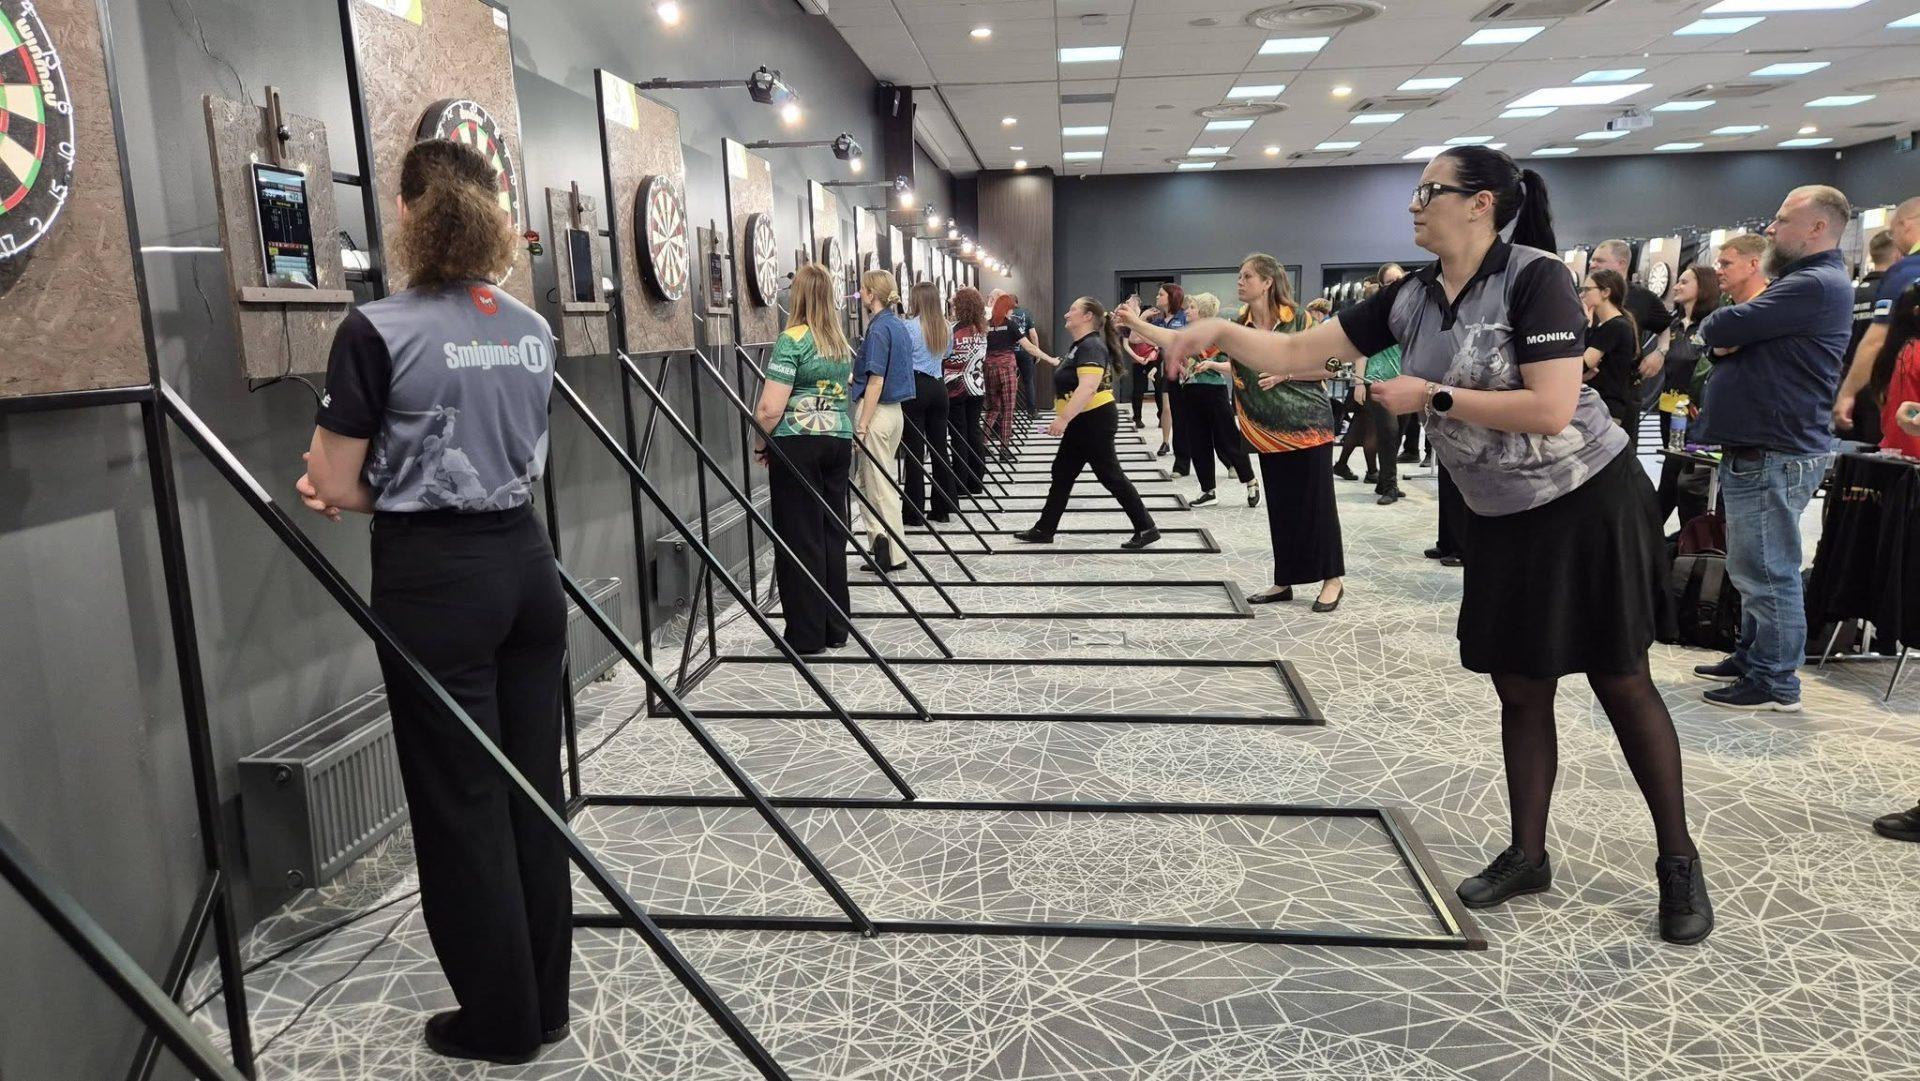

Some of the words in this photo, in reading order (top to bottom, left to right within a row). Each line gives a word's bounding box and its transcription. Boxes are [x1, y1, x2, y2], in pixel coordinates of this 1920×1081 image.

[48, 179, 68, 205] 15
[29, 217, 44, 233] 2
[1526, 331, 1576, 345] MONIKA
[443, 338, 520, 370] Smiginis
[523, 340, 543, 368] LT
